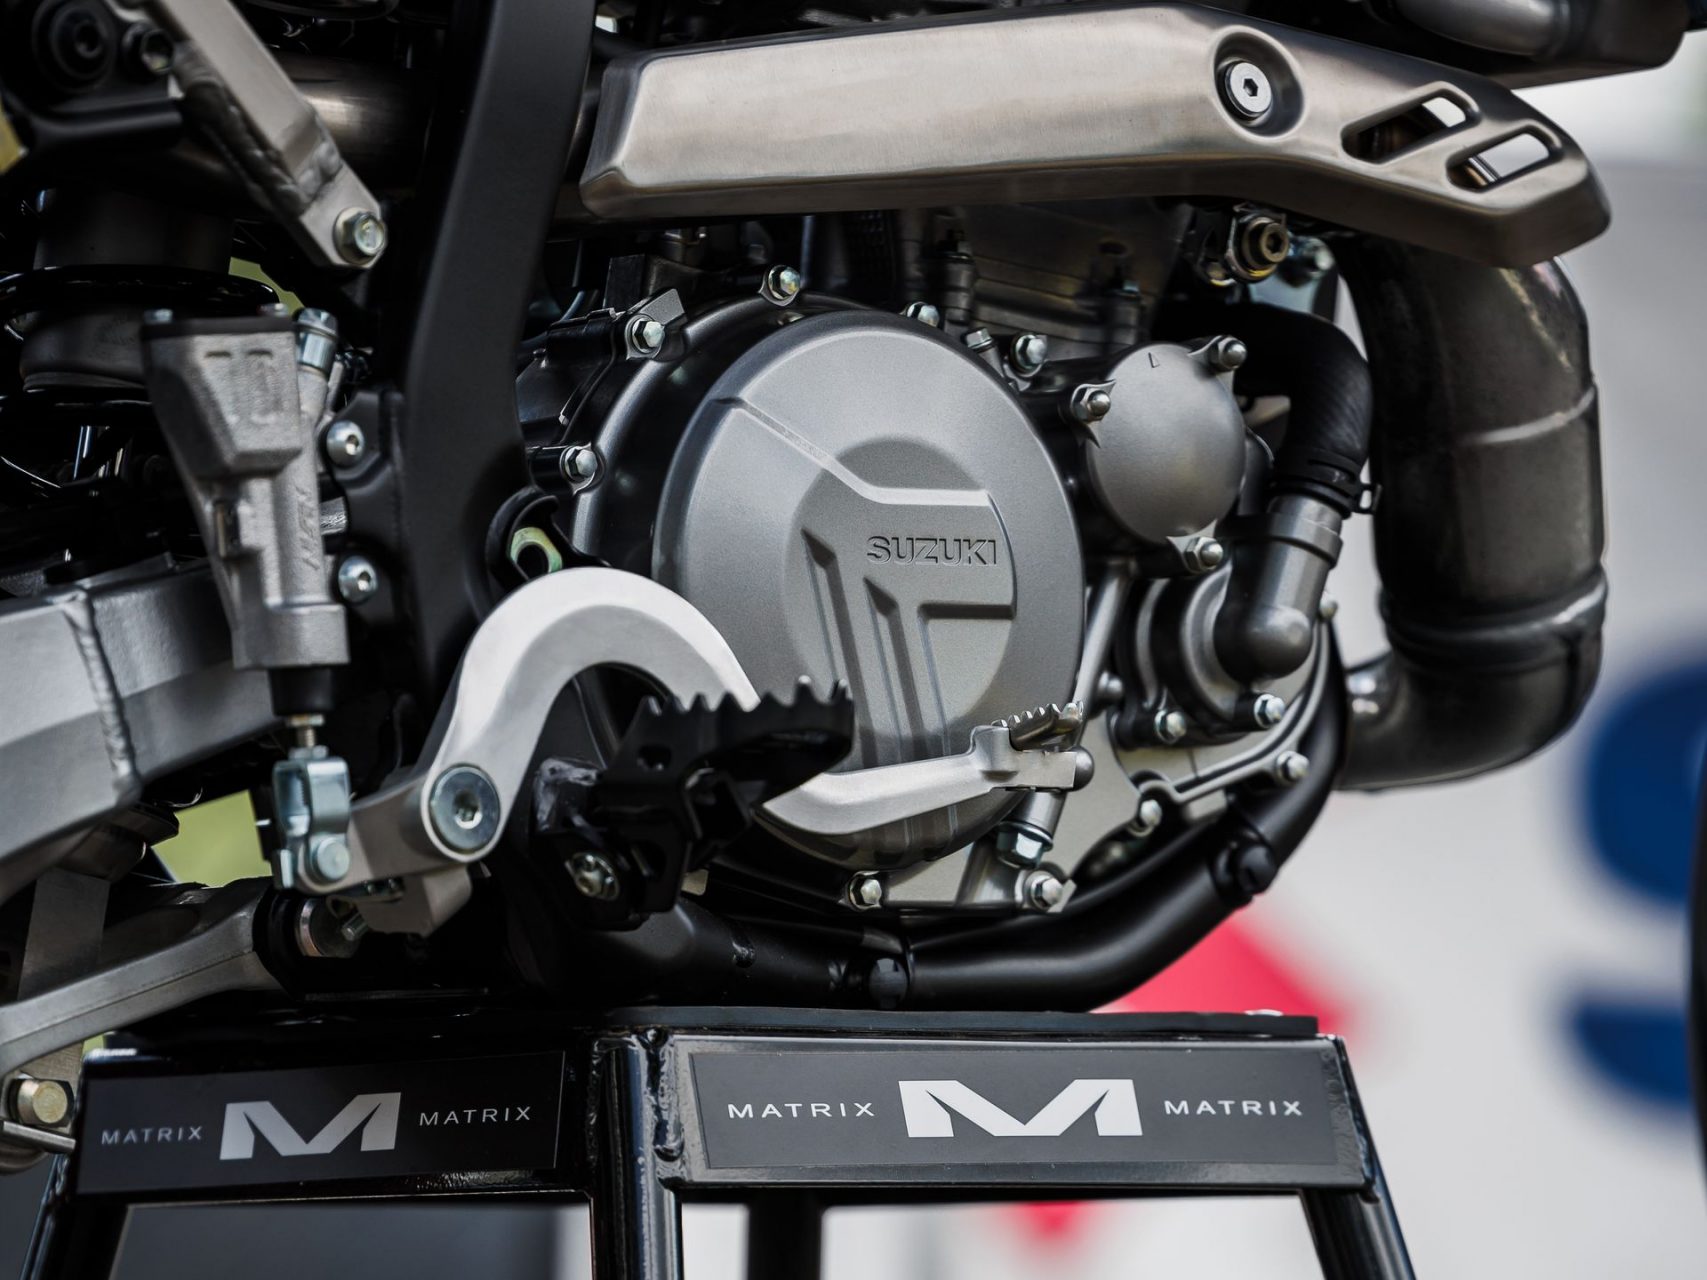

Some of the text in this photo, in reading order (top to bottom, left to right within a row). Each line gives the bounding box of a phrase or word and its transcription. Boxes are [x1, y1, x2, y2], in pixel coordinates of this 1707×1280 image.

[867, 536, 998, 567] SUZUKI
[727, 1102, 876, 1119] MATRIX
[1163, 1099, 1304, 1117] MATRIX
[101, 1125, 204, 1145] MATRIX
[419, 1106, 533, 1127] MATRIX
